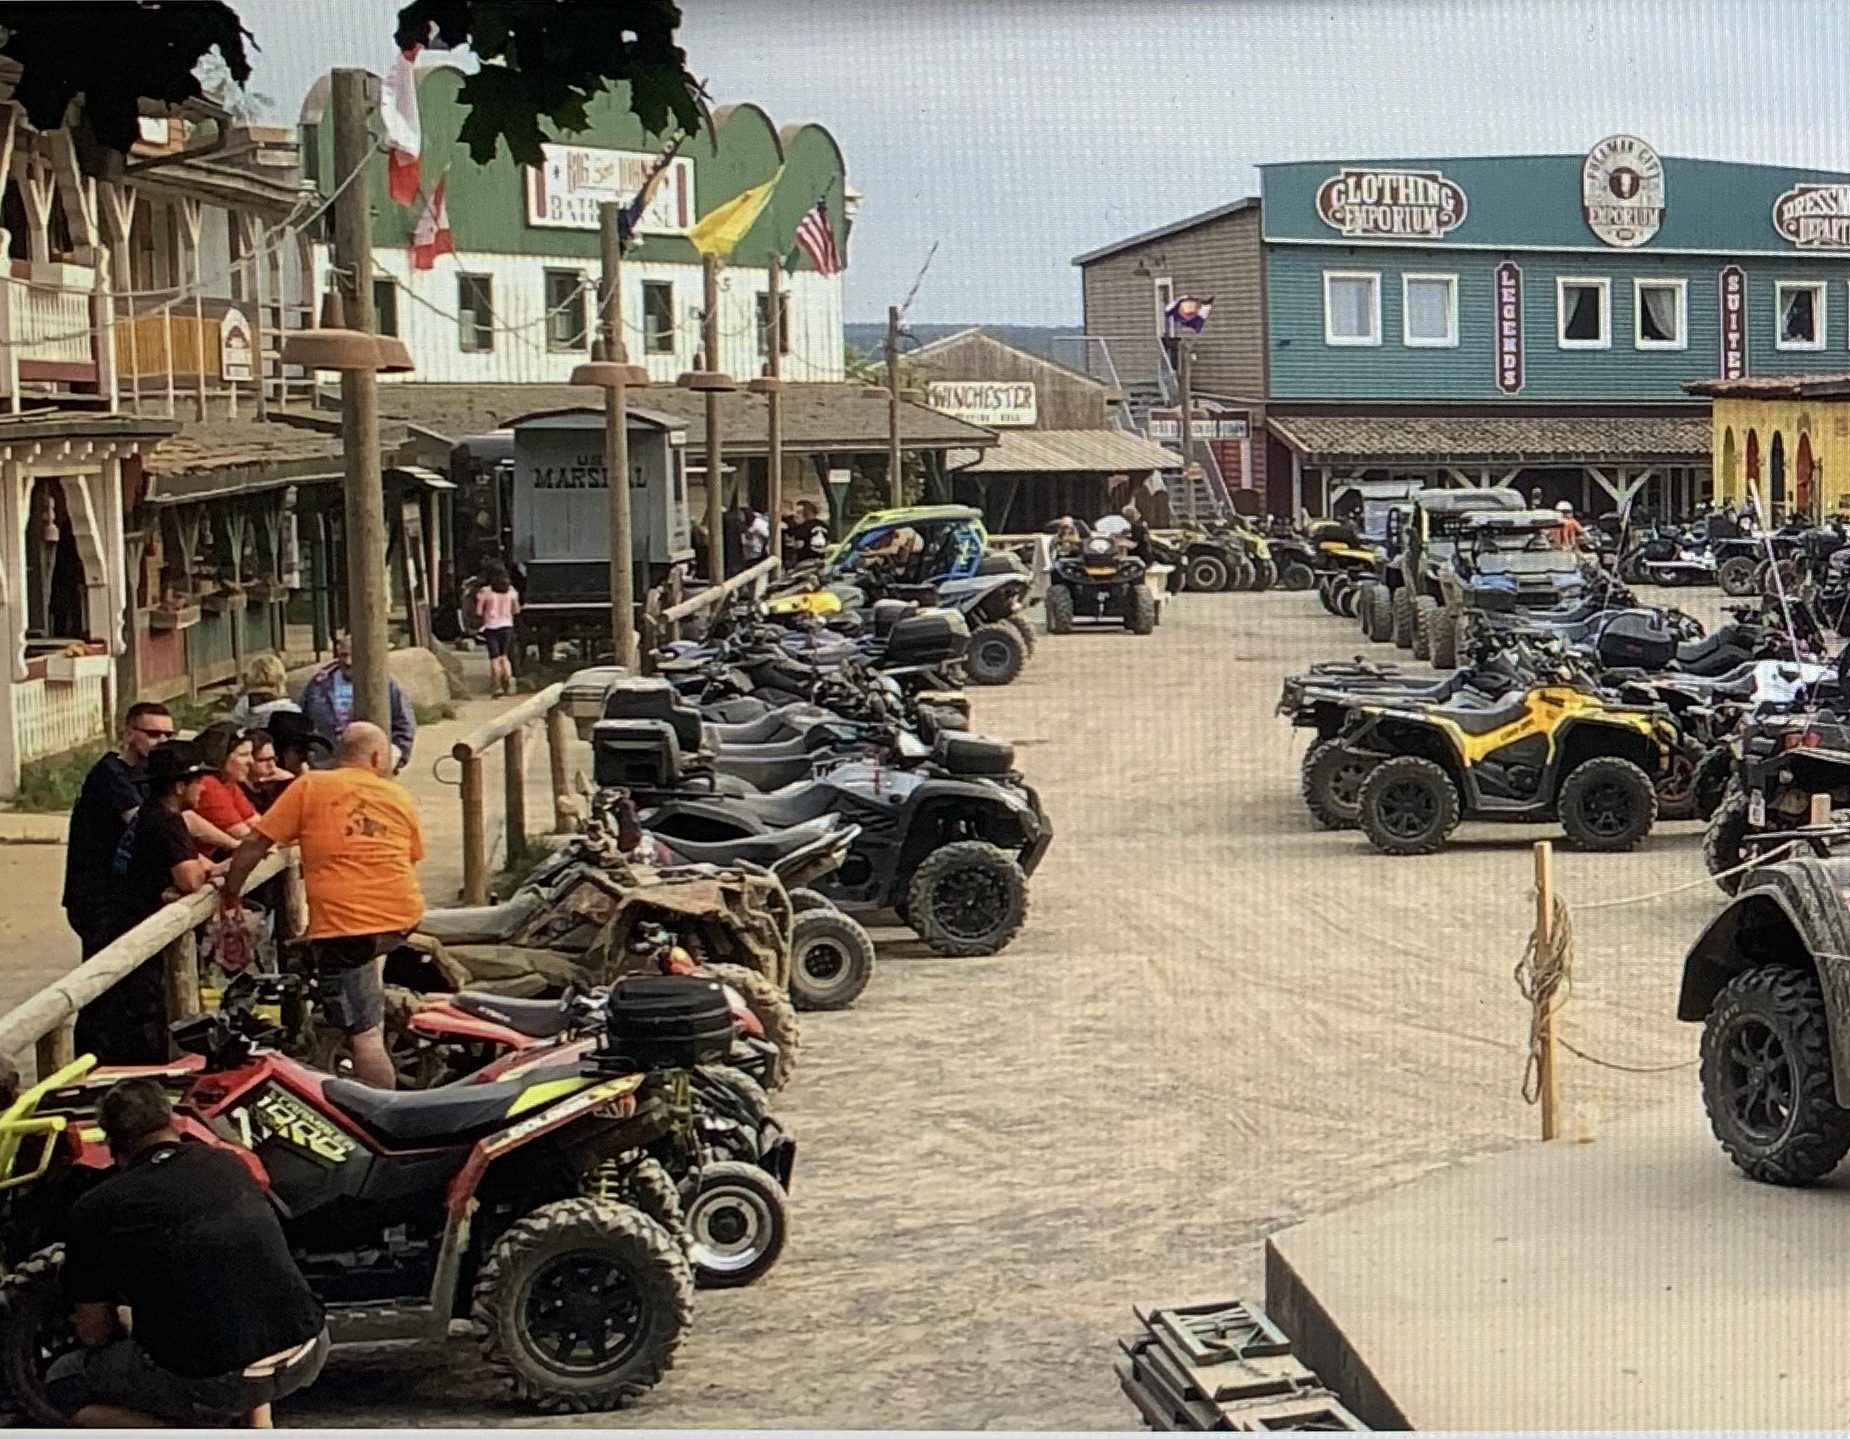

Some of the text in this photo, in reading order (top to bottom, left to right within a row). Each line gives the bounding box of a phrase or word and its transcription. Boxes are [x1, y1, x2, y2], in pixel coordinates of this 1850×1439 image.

[1330, 173, 1455, 211] CLOTHING
[1343, 204, 1439, 235] EMPORIUM
[1588, 206, 1658, 227] EMPORIUM
[1501, 270, 1517, 386] LEGENDS
[1727, 274, 1741, 379] SUITES
[924, 385, 1033, 409] WINCHESTER
[532, 467, 648, 489] MARSL
